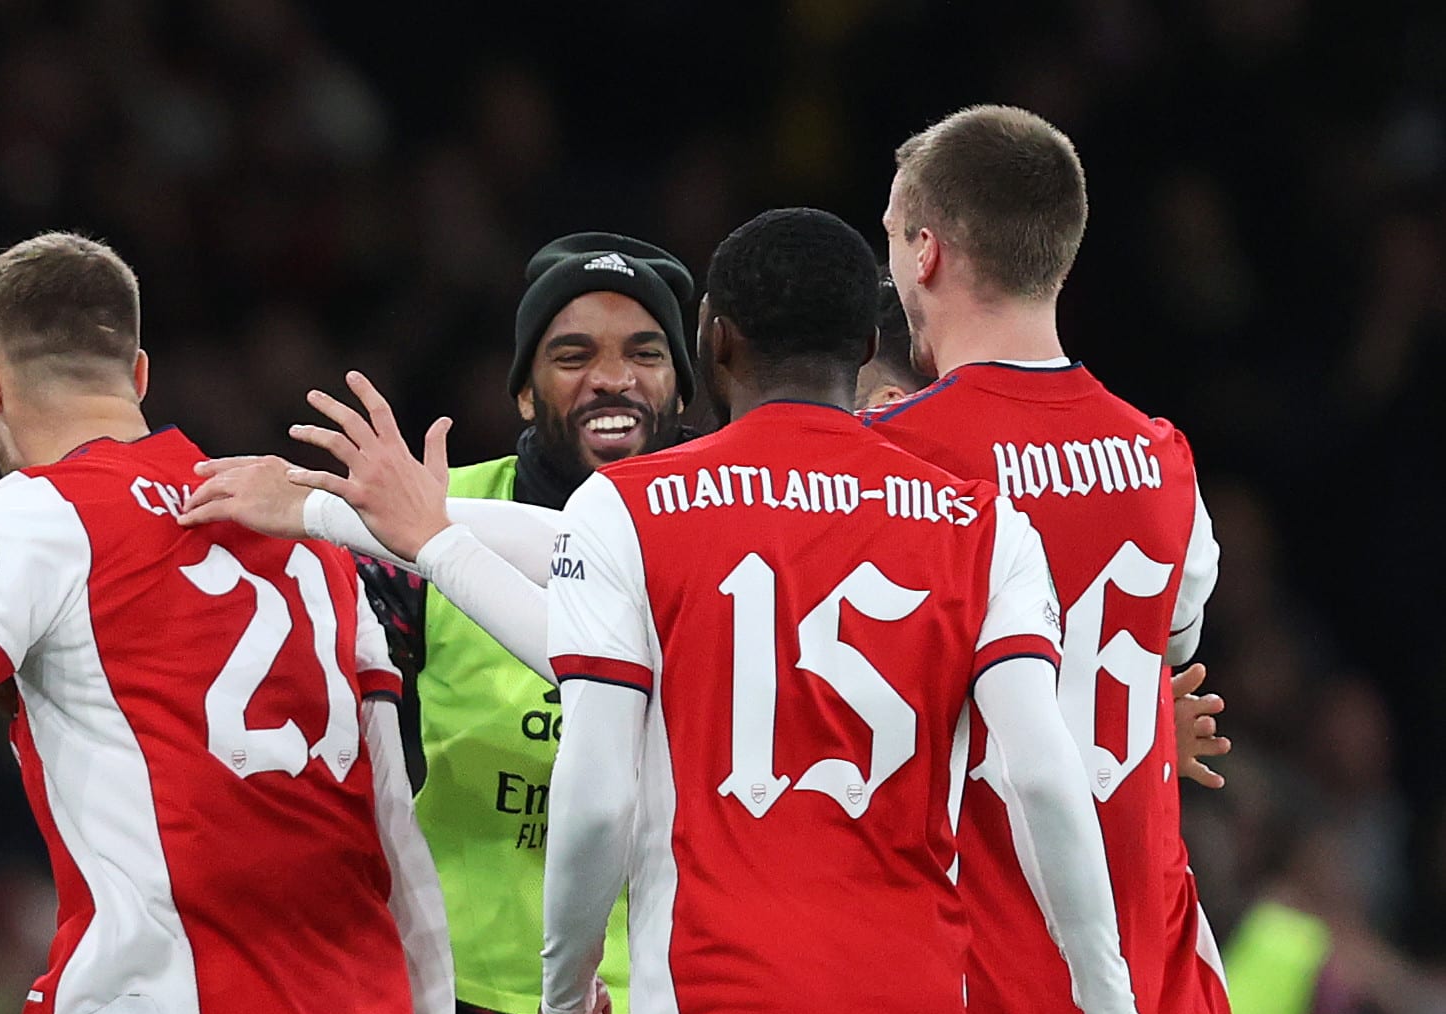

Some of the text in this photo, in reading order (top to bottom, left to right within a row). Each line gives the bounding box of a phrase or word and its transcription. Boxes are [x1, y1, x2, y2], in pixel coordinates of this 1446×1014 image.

[584, 263, 635, 277] adidas
[646, 465, 979, 526] MAITLAND-NILES
[993, 434, 1162, 499] HOLDING
[178, 543, 360, 784] 21
[717, 552, 931, 819] 15
